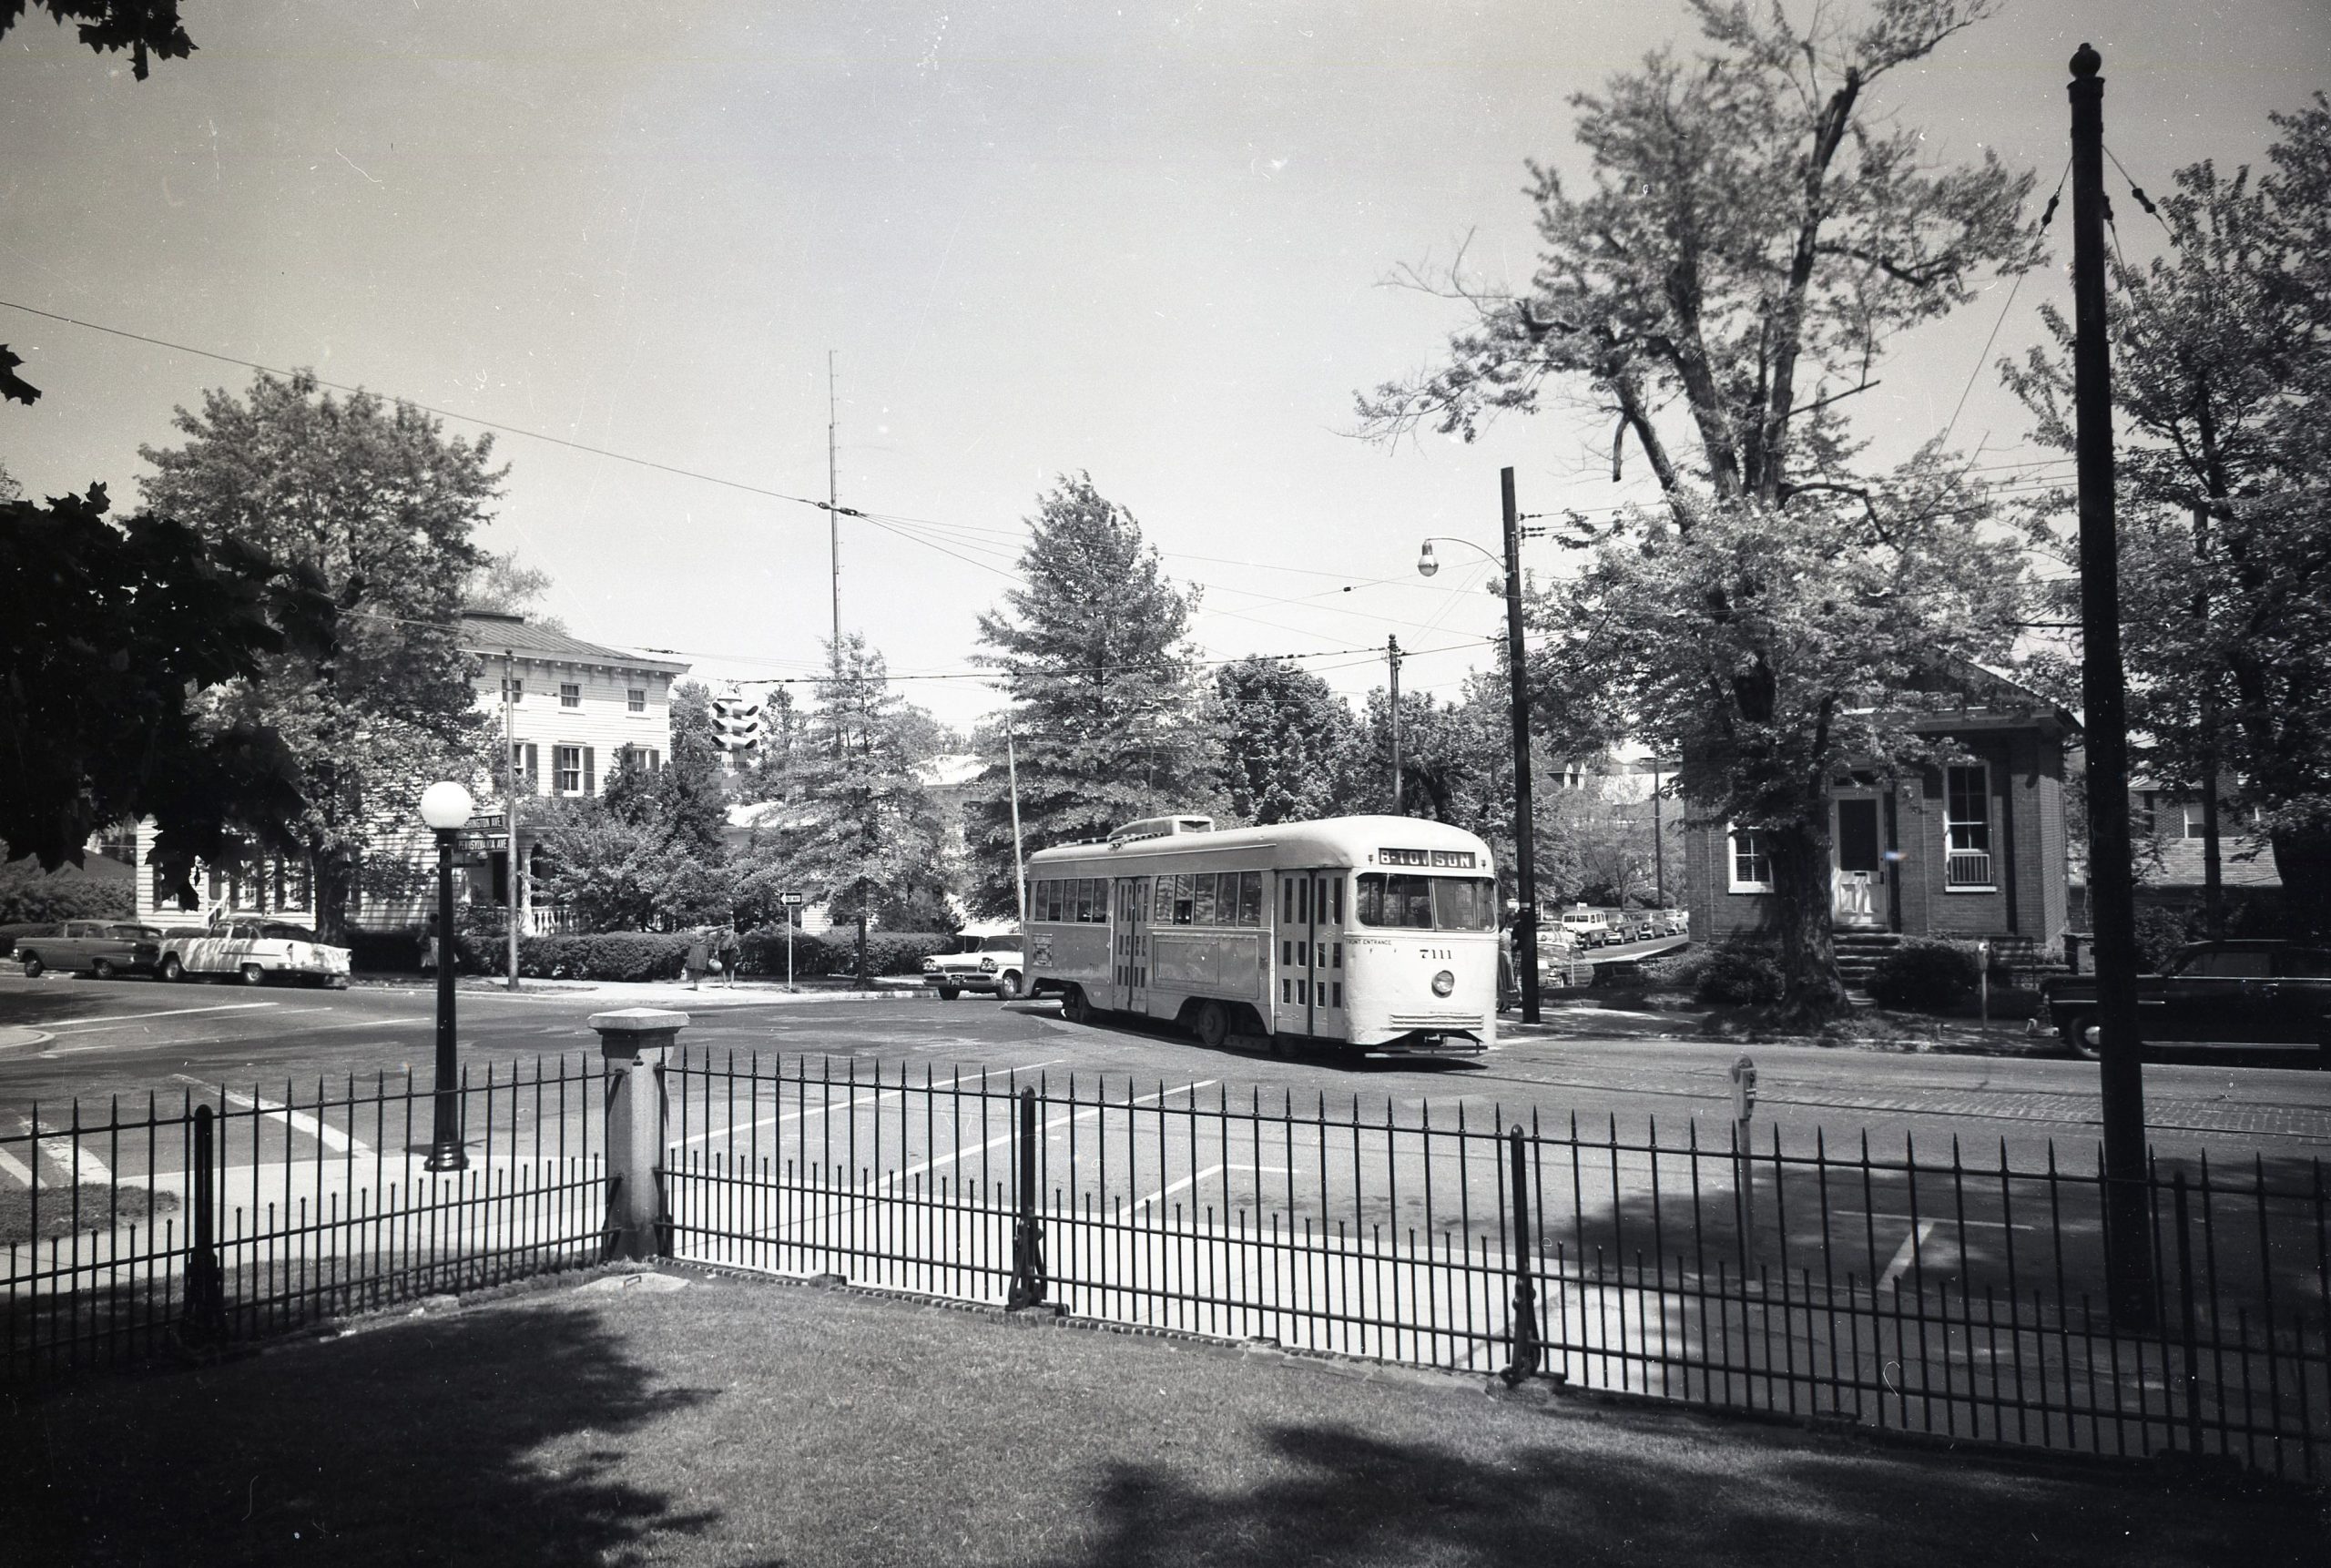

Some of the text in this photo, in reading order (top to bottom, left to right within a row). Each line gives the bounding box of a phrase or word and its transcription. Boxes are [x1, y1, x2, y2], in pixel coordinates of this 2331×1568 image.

[459, 839, 507, 850] PENNSYLVANIA AVE
[1420, 949, 1452, 960] 7111
